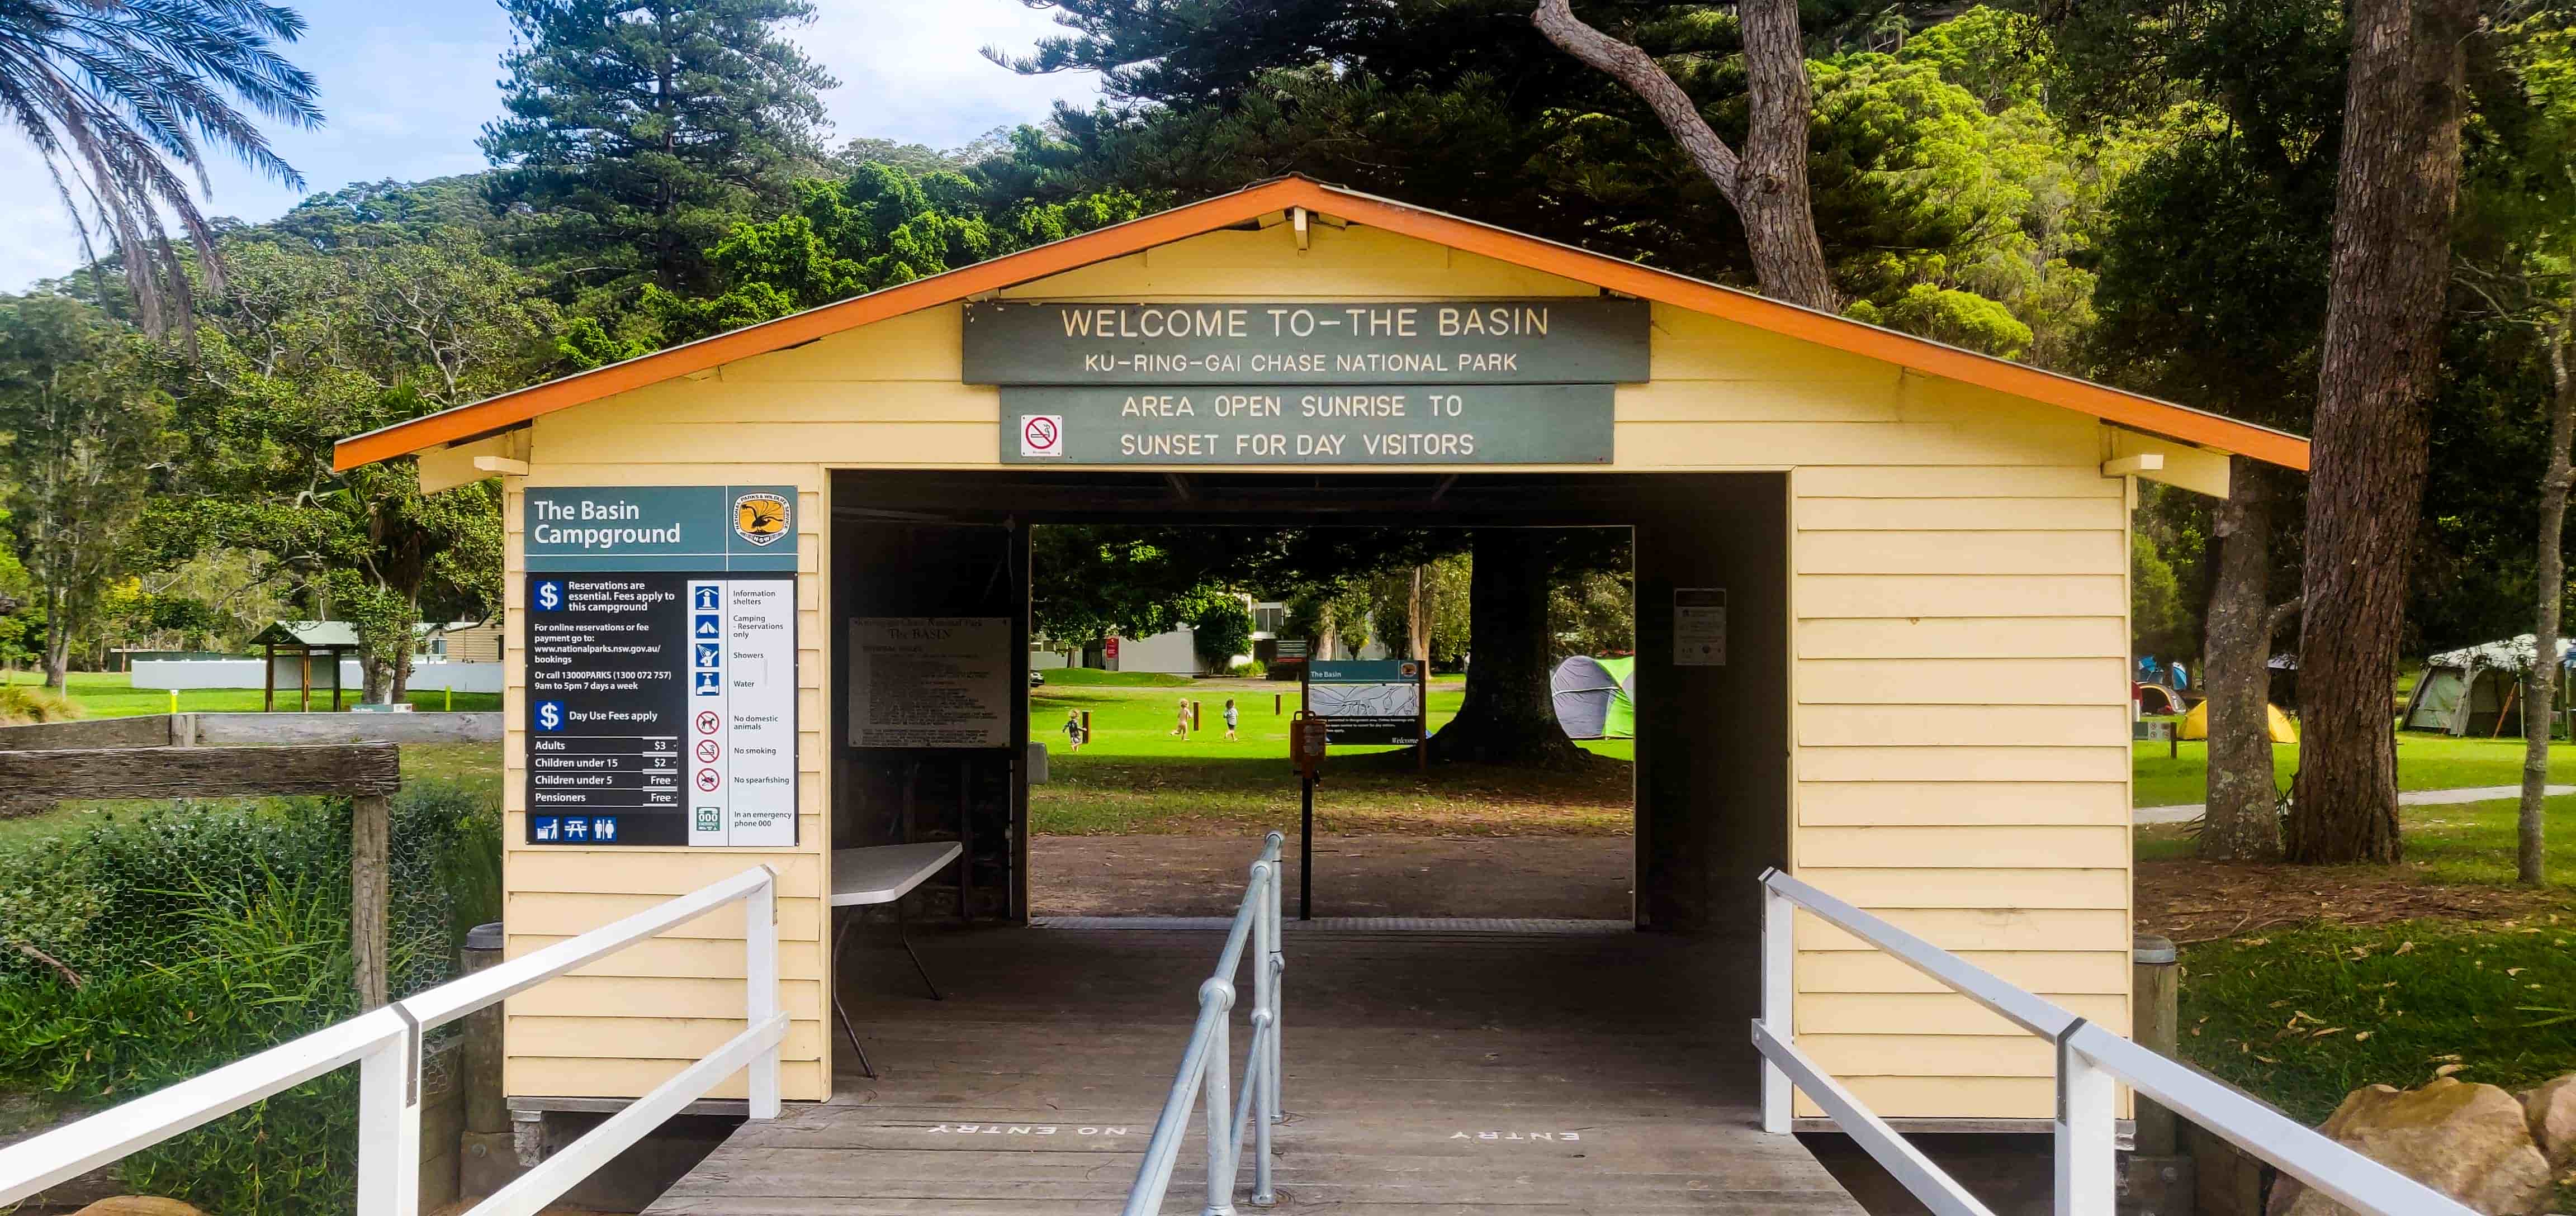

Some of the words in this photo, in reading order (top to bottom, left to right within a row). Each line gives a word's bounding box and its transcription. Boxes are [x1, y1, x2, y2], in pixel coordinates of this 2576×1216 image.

[1061, 308, 1249, 338] WELCOME
[1438, 307, 1549, 336] BASIN
[1084, 354, 1241, 373] KU-RING-GAI
[1251, 354, 1327, 373] CHASE
[1336, 354, 1448, 373] NATIONAL
[1457, 354, 1518, 372] PARK
[1121, 396, 1195, 417] AREA
[1214, 396, 1281, 417] OPEN
[1301, 396, 1406, 417] SUNRISE
[1428, 396, 1463, 417] TO
[1120, 434, 1219, 456] SUNSET
[1235, 434, 1287, 455] FOR
[1296, 434, 1346, 455] DAY
[1363, 434, 1474, 455] VISITORS
[534, 501, 575, 520] The
[581, 501, 640, 520] Basin
[534, 523, 680, 548] Campground
[569, 581, 628, 591] Reservations
[539, 582, 558, 609] $
[569, 592, 612, 601] essential.
[614, 592, 634, 601] Fees
[636, 592, 663, 603] apply
[569, 602, 586, 611] this
[588, 602, 647, 614] campground
[733, 615, 765, 623] Camping
[534, 624, 548, 632] For
[550, 624, 574, 632] online
[576, 624, 624, 632] reservations
[534, 634, 570, 644] payment
[571, 635, 582, 644] go
[583, 634, 595, 643] to:
[733, 631, 750, 639] only
[534, 644, 661, 654] www.nationalparks.nsw.gov.au/
[534, 655, 572, 665] bookings
[534, 671, 545, 680] Or
[546, 671, 560, 680] call
[562, 671, 611, 680] 13000PARKS
[613, 671, 634, 681] (1300
[636, 671, 651, 680] 072
[652, 671, 671, 681] 757)
[534, 682, 552, 691] 9am
[564, 682, 582, 692] 5pm
[583, 682, 589, 691] 7
[590, 682, 609, 692] days
[616, 682, 638, 691] week
[540, 702, 559, 729] $
[569, 711, 588, 723] Day
[589, 711, 606, 720] Use
[608, 711, 629, 720] Fees
[631, 711, 657, 723] apply
[535, 741, 565, 750] Adults
[654, 741, 666, 751] $3
[746, 747, 776, 757] smoking
[535, 758, 575, 768] Children
[576, 758, 604, 768] under
[607, 759, 618, 768] 15
[654, 759, 666, 768] $2
[535, 775, 575, 785] Children
[576, 775, 604, 785] under
[607, 776, 613, 785] 5
[651, 776, 671, 785] Free
[746, 776, 789, 786] spearfishing
[535, 792, 586, 802] Pensioners
[651, 794, 671, 802] Free
[698, 813, 718, 823] 000
[752, 813, 792, 821] emergency
[734, 819, 756, 828] phone
[927, 1125, 1058, 1135] ENTRY
[1077, 1127, 1127, 1136] NO
[1450, 1132, 1580, 1141] ENTRY
